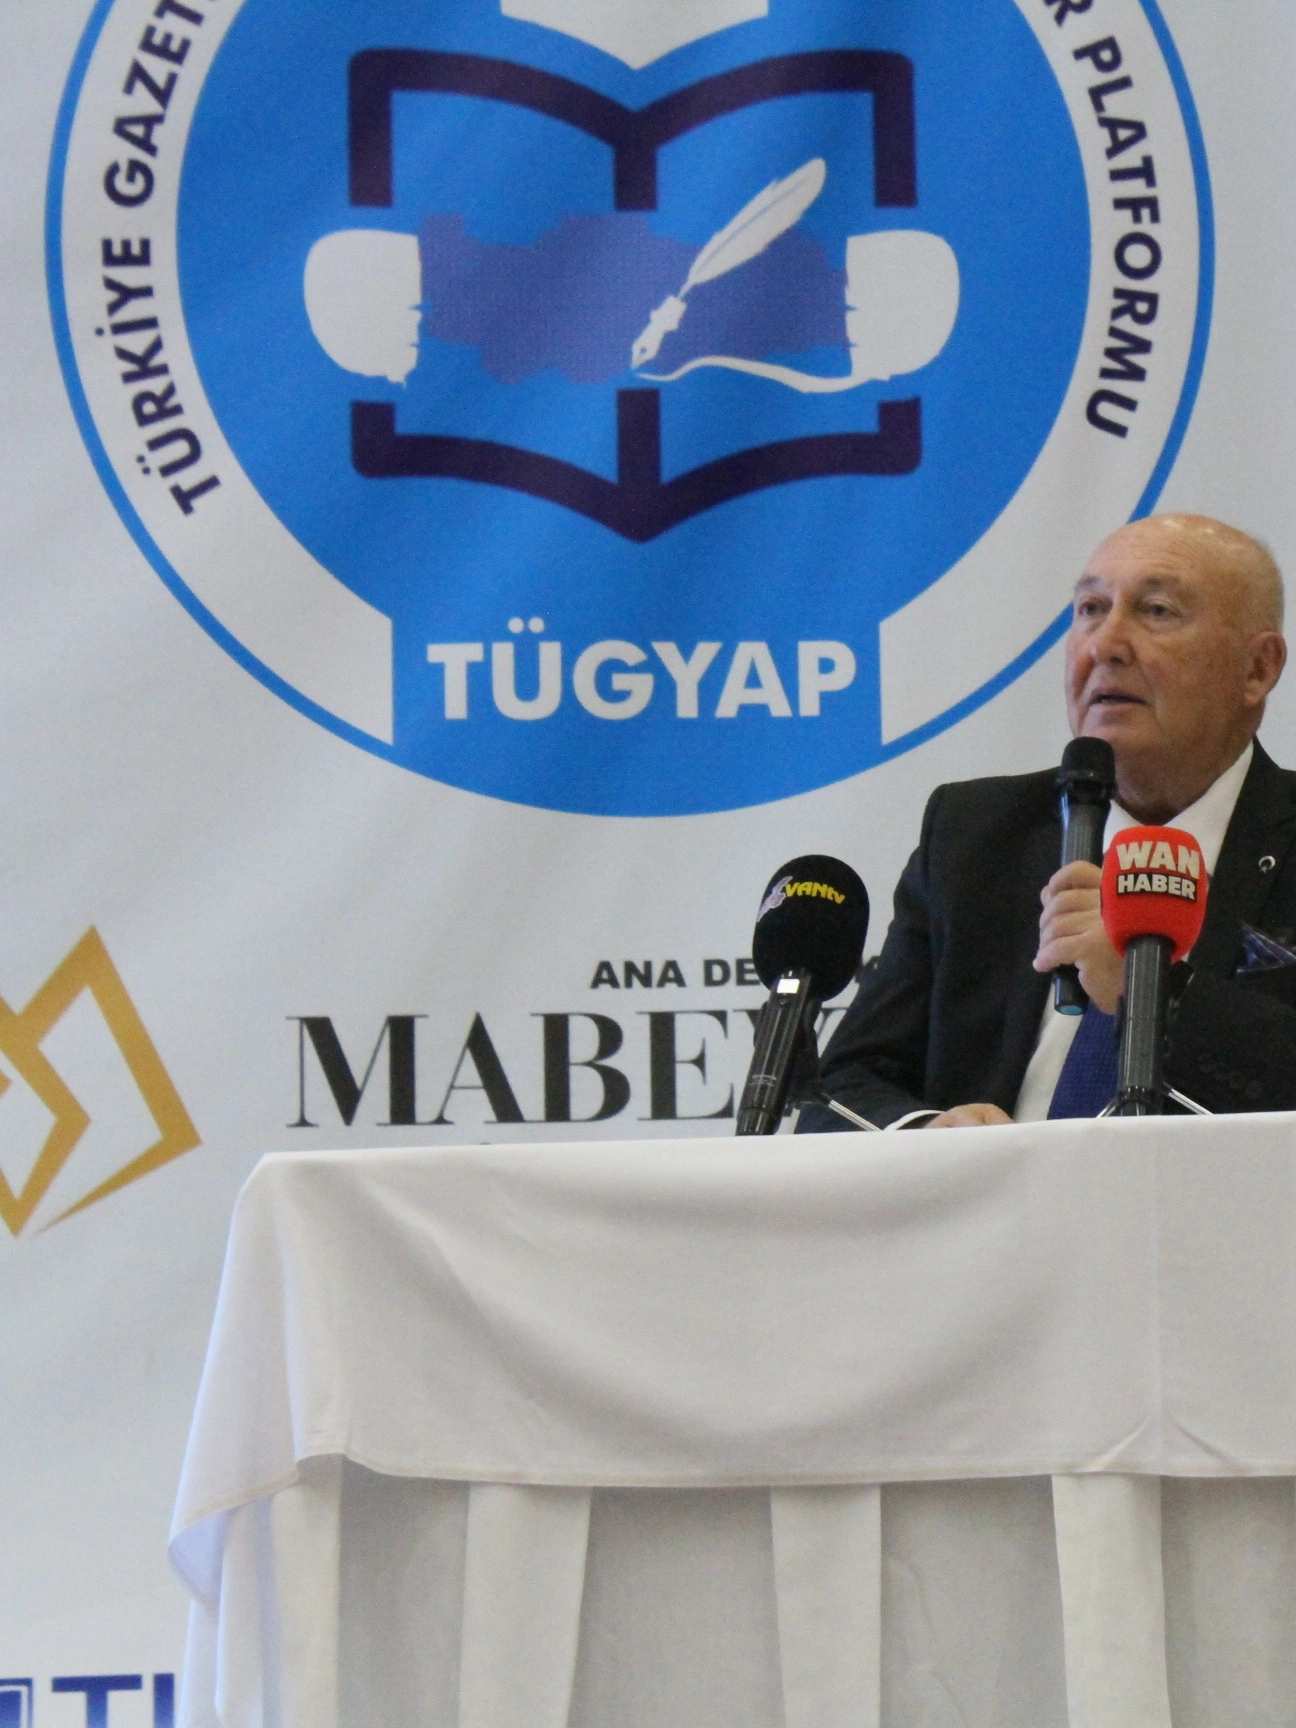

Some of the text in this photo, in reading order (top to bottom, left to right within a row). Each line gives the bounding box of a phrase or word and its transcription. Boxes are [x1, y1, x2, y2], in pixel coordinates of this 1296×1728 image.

[1072, 34, 1163, 439] PLATFORMU
[94, 236, 221, 516] TÜRKİYE
[426, 616, 858, 722] TÜGYAP
[1115, 840, 1200, 880] WAN
[1117, 873, 1196, 901] HABER
[590, 960, 687, 989] ANA
